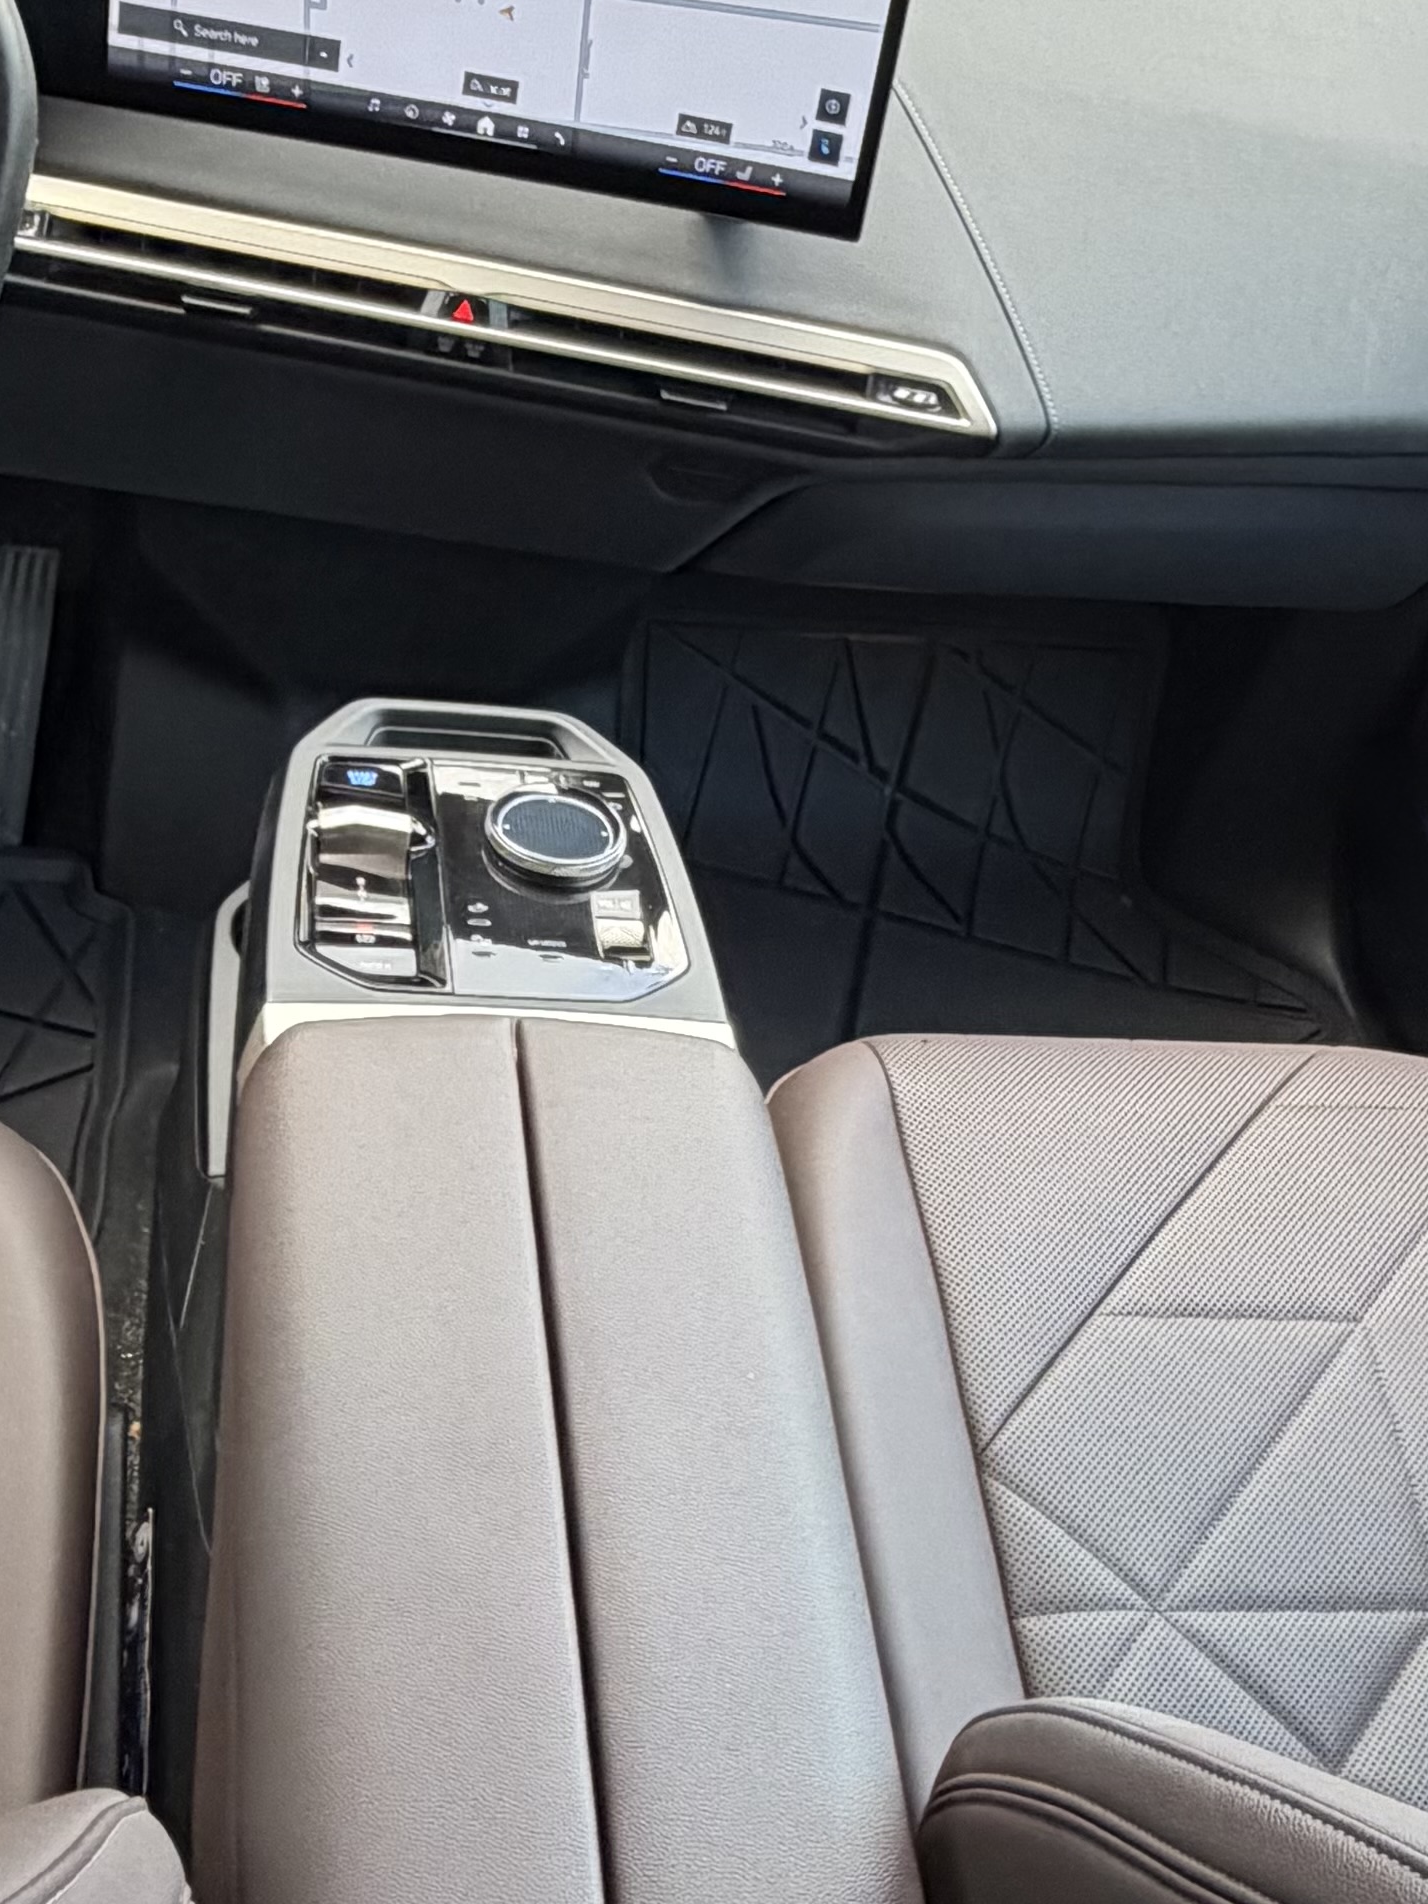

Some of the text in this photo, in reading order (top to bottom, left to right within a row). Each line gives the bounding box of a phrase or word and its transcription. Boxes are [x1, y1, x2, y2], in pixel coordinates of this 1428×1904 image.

[194, 24, 260, 47] Search here
[209, 68, 244, 88] OFF
[694, 156, 728, 175] OFF
